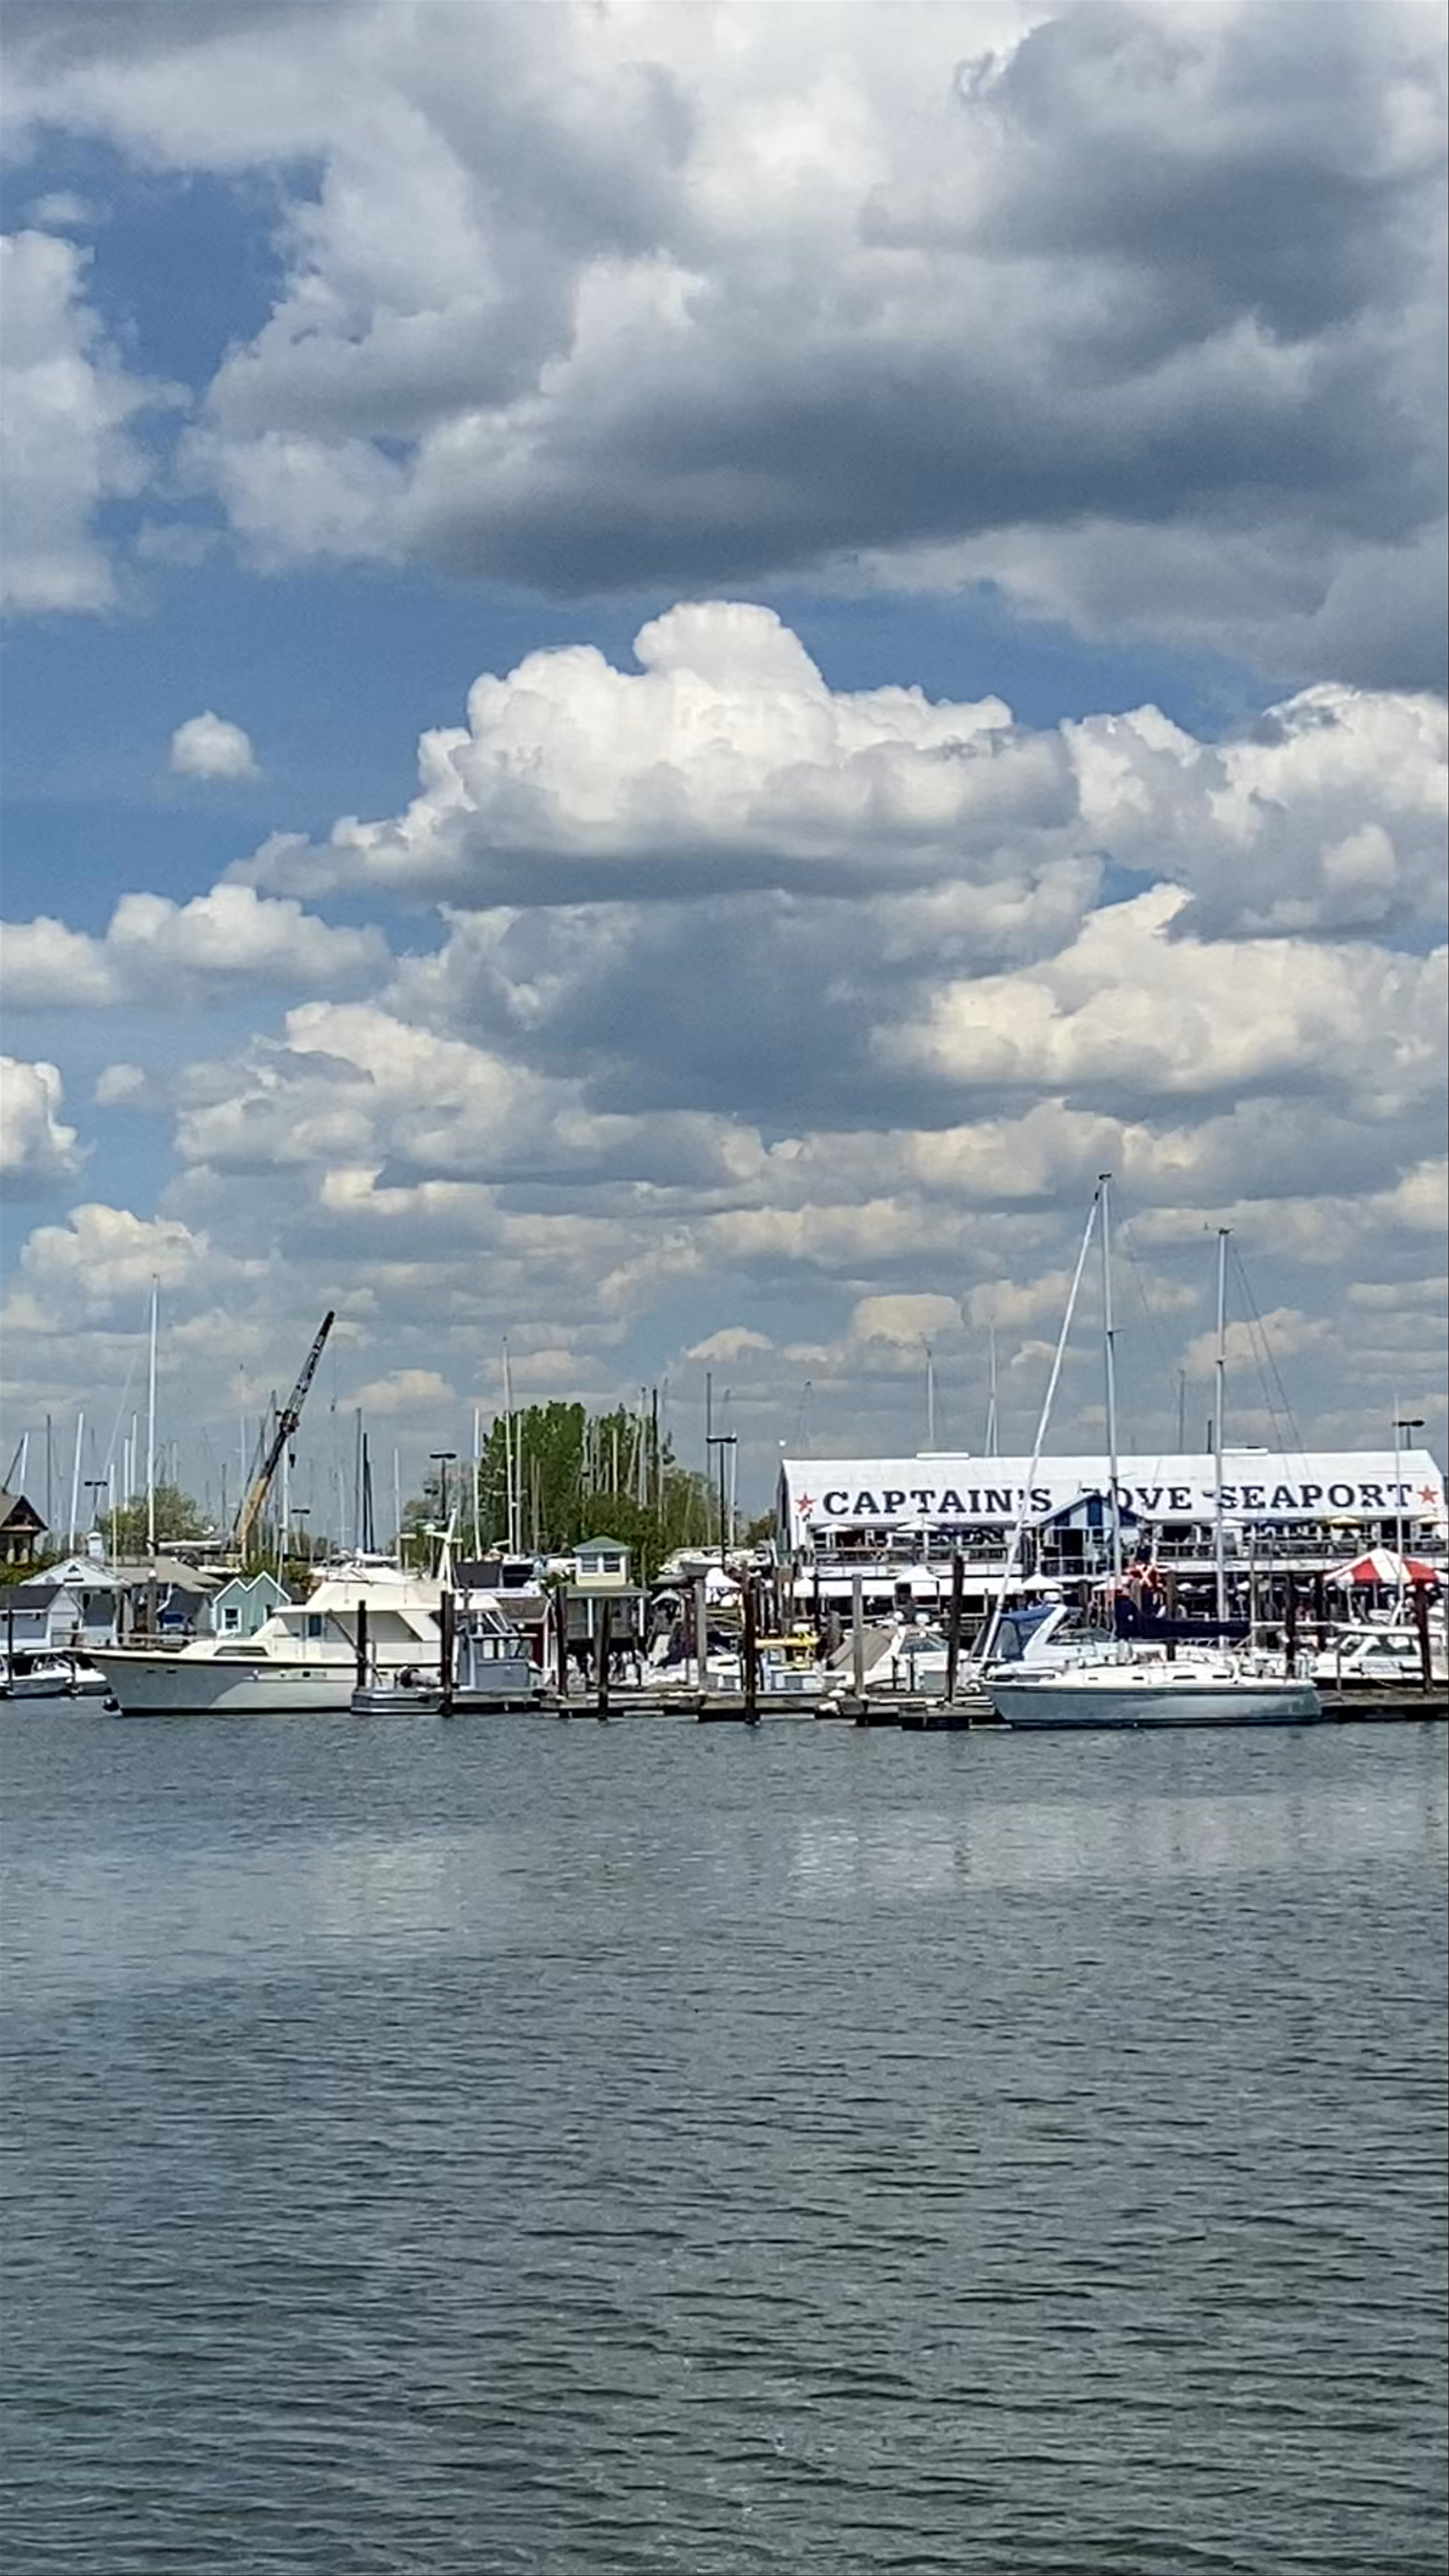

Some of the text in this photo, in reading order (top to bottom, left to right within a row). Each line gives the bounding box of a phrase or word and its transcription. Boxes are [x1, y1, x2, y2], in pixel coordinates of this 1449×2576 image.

[823, 1484, 1412, 1515] CAPTAIN'S OVE SEAPORT
